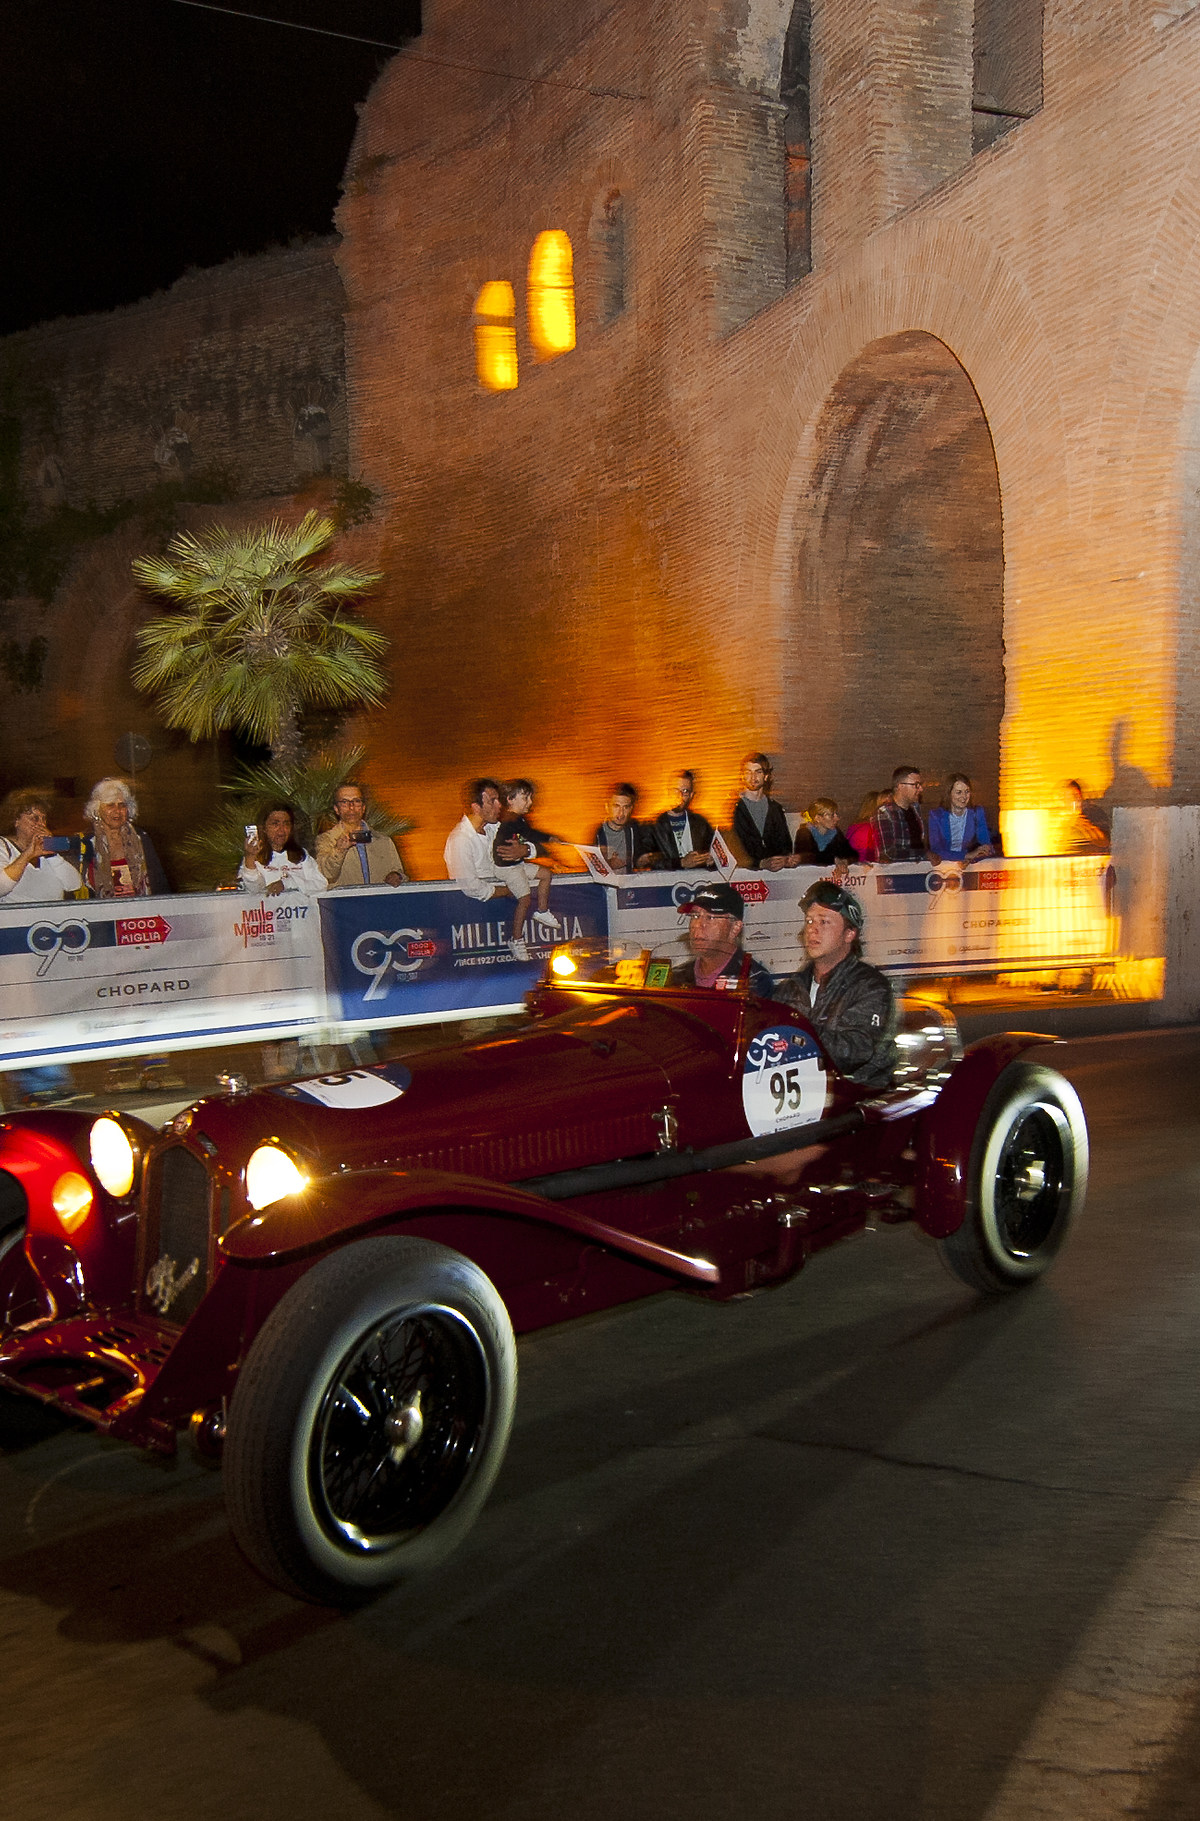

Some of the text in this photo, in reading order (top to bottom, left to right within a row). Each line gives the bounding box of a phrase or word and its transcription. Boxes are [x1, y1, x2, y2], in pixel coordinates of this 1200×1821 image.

[844, 876, 867, 887] 2017
[242, 900, 308, 922] Mille 2017
[122, 919, 158, 932] 1000
[121, 931, 162, 944] MIGLIA
[233, 919, 275, 949] Miglia
[451, 921, 506, 950] MILLE
[477, 956, 496, 965] 1927
[652, 969, 662, 981] 2
[97, 979, 191, 999] CHOPARD
[770, 1068, 802, 1115] 95
